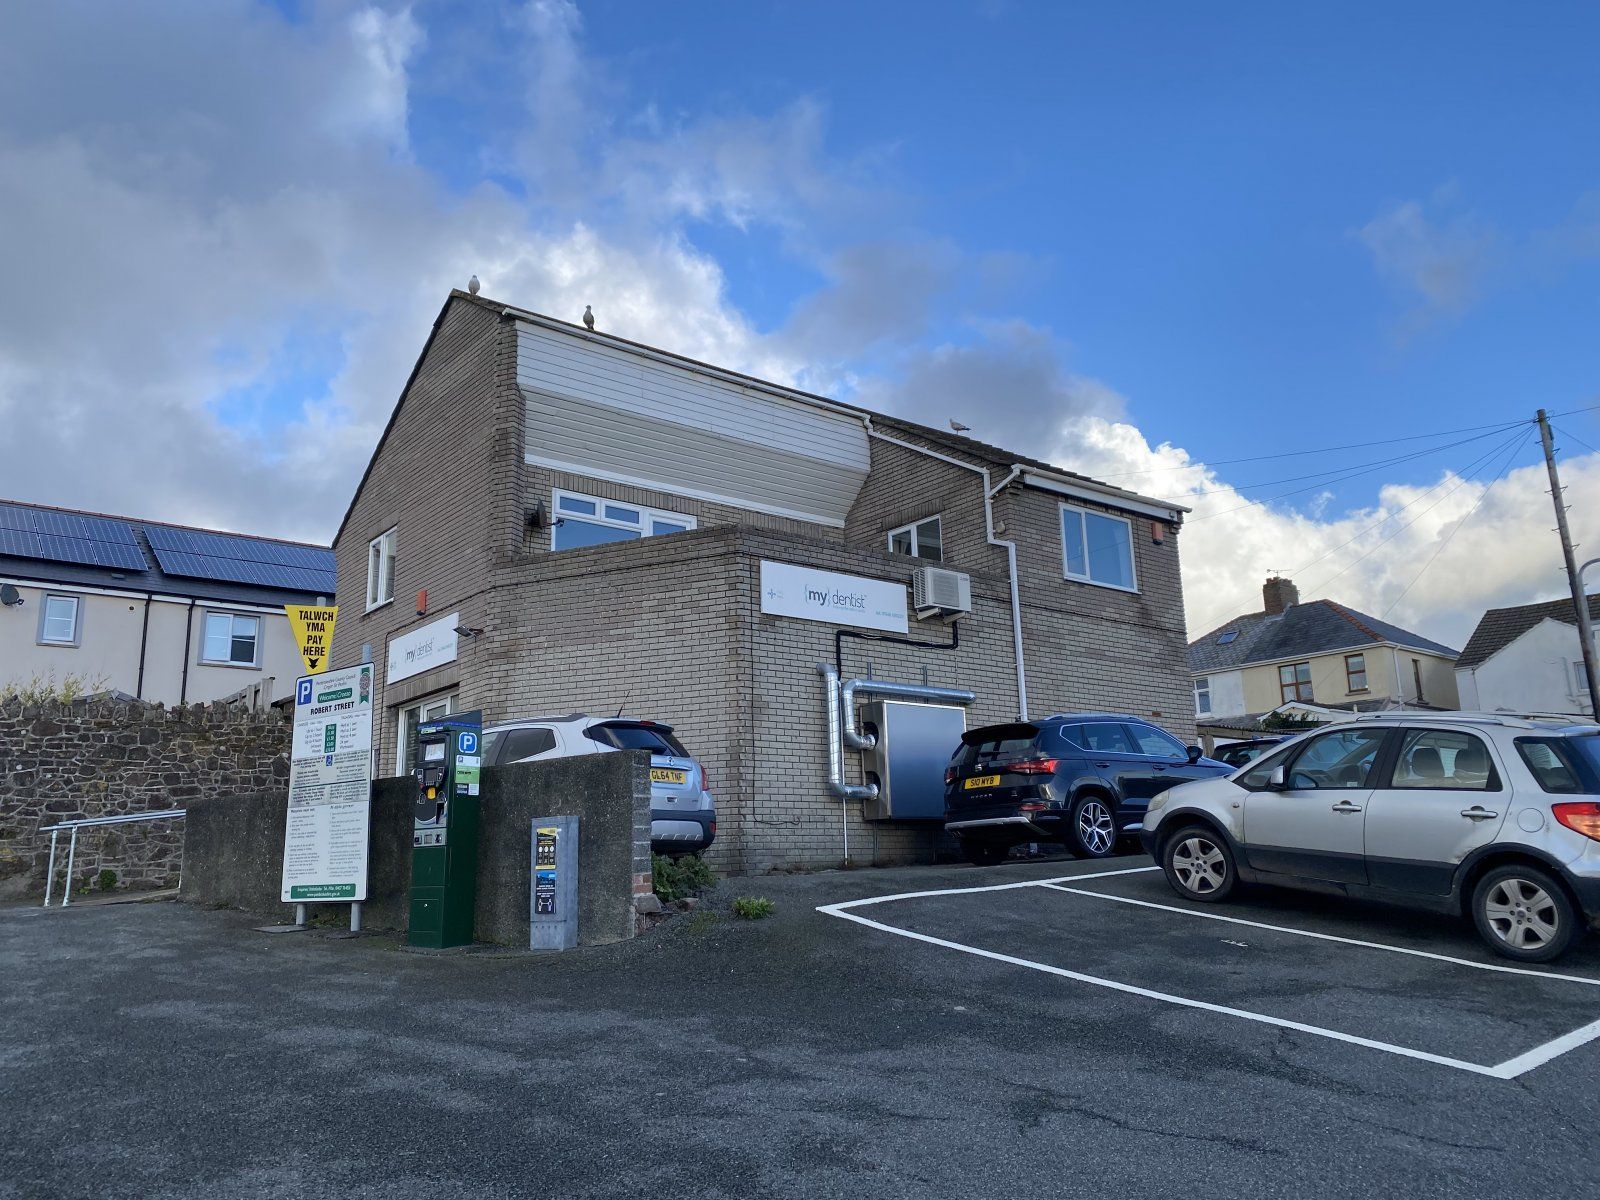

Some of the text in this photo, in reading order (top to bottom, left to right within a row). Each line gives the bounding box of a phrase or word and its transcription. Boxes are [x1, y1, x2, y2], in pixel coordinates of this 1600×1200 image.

[299, 610, 334, 621] TALWCH
[306, 622, 325, 632] YMA
[306, 635, 323, 645] PAY
[303, 646, 325, 656] HERE
[301, 682, 311, 703] P
[310, 701, 355, 716] ROBERT STREET
[464, 735, 473, 750] P
[651, 770, 670, 780] GL64
[981, 776, 995, 786] MYB
